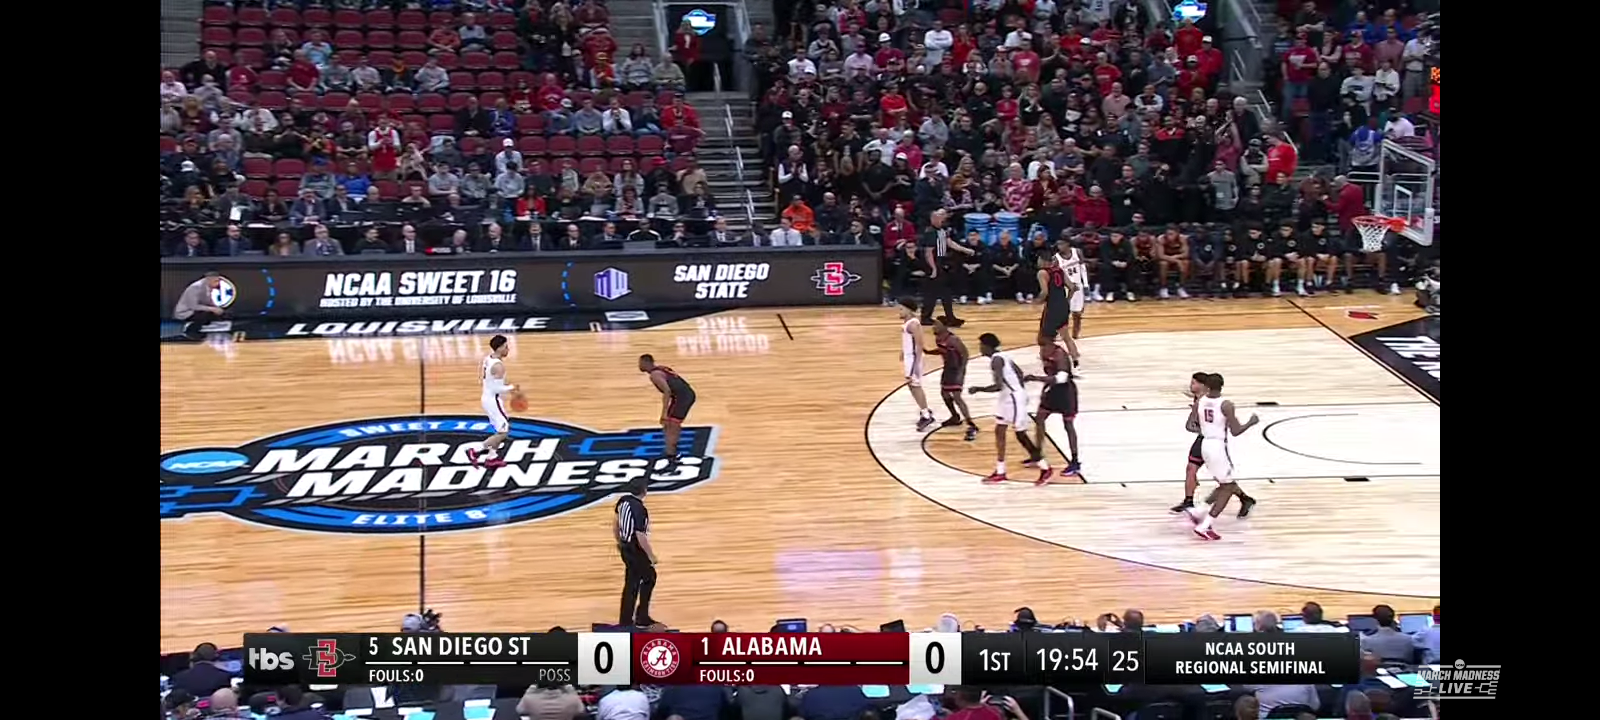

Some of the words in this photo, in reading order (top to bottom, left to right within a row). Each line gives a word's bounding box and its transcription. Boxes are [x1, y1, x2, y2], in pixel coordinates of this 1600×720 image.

[673, 264, 711, 283] SAN
[713, 263, 770, 281] DIEGO
[323, 271, 393, 297] NCAA
[398, 269, 486, 295] SWEET
[489, 269, 517, 293] 16
[694, 281, 750, 299] STATE
[319, 297, 359, 308] HOSTED
[359, 297, 375, 307] BY
[375, 296, 394, 306] THE
[451, 294, 465, 305] OF
[465, 293, 517, 304] LOUISVILLE
[287, 317, 552, 335] LOUISVILLE
[1203, 408, 1215, 423] 15
[338, 420, 442, 438] SWEET
[453, 421, 490, 431] 16
[250, 438, 561, 474] MARCH
[286, 455, 703, 497] MADNESS
[350, 512, 453, 526] ELITE
[465, 508, 488, 520] 8
